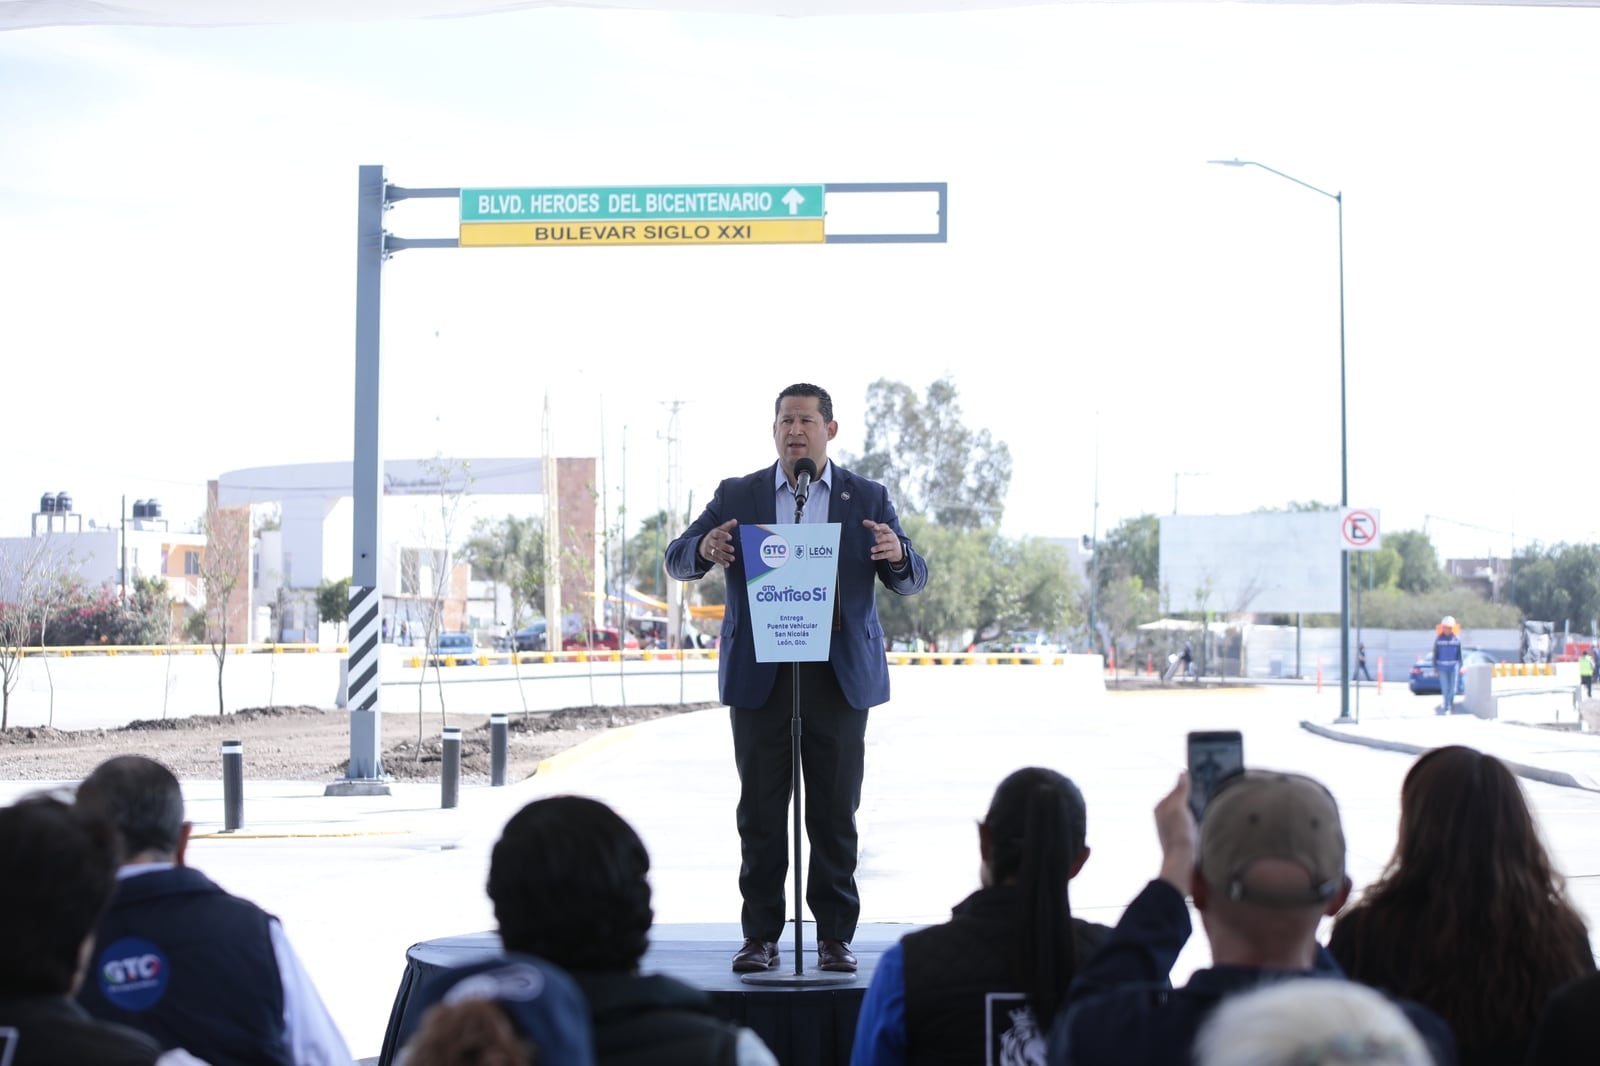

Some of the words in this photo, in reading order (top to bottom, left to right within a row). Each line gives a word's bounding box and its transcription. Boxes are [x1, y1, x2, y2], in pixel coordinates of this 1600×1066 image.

[478, 194, 525, 214] BLVD.
[530, 193, 600, 213] HEROES
[608, 194, 642, 213] DEL
[645, 191, 773, 213] BICENTENARIO
[535, 226, 636, 240] BULEVAR
[643, 225, 710, 239] SIGLO
[717, 225, 751, 239] XXI
[763, 544, 787, 555] GTO
[809, 545, 833, 556] LEÓN
[104, 953, 161, 984] GTO
